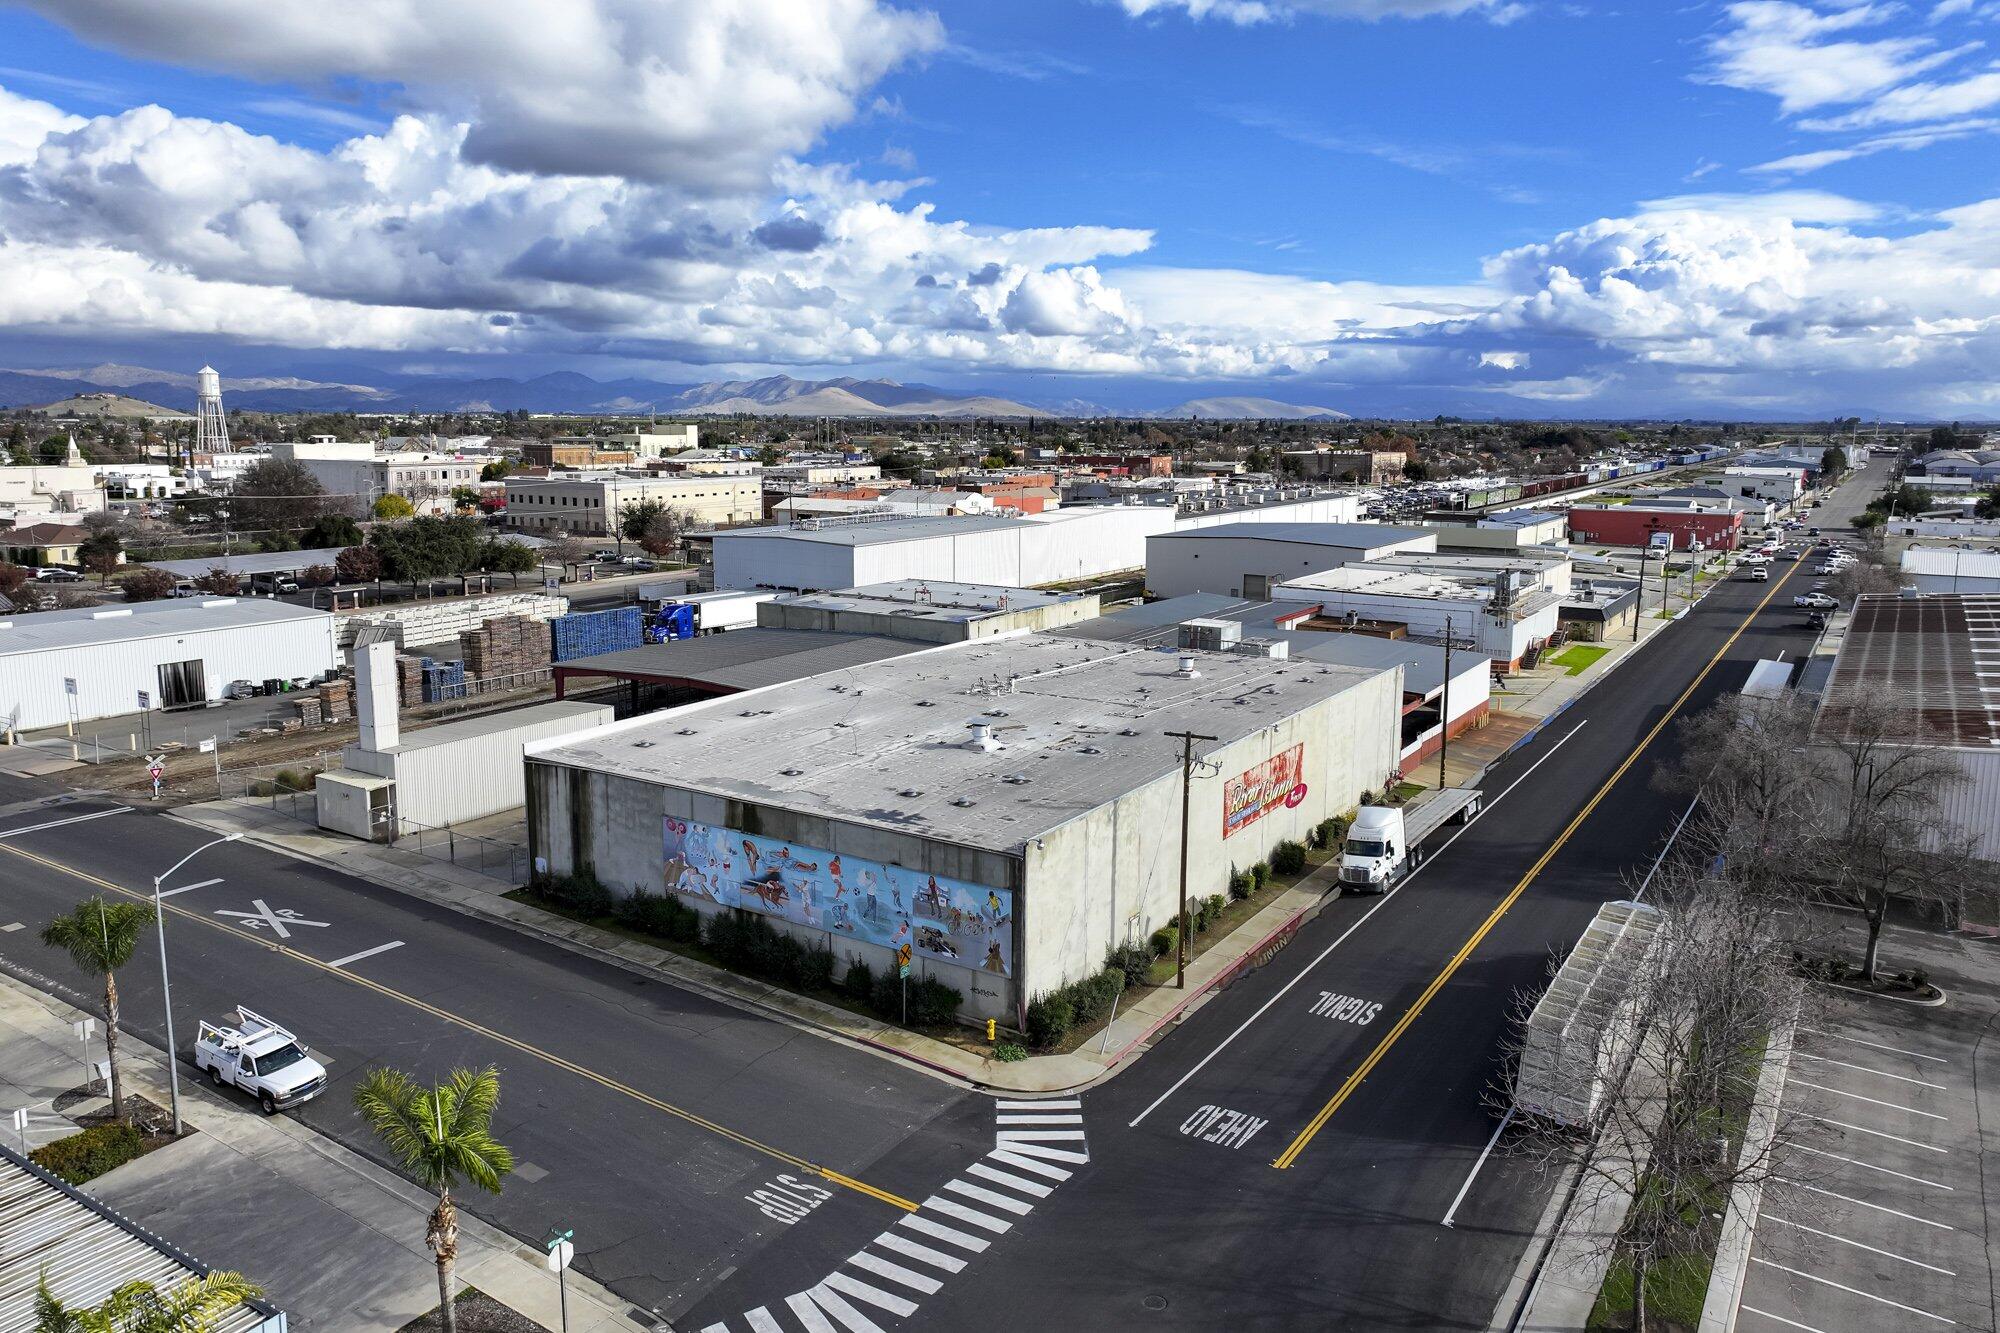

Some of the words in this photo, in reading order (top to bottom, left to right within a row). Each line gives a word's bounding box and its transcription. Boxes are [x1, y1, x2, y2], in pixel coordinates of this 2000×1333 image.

[1229, 783, 1260, 815] River
[1258, 776, 1294, 810] Island
[1308, 991, 1383, 1026] SIGNAL
[1180, 1105, 1269, 1150] AHEAD
[744, 1174, 833, 1225] STOP
